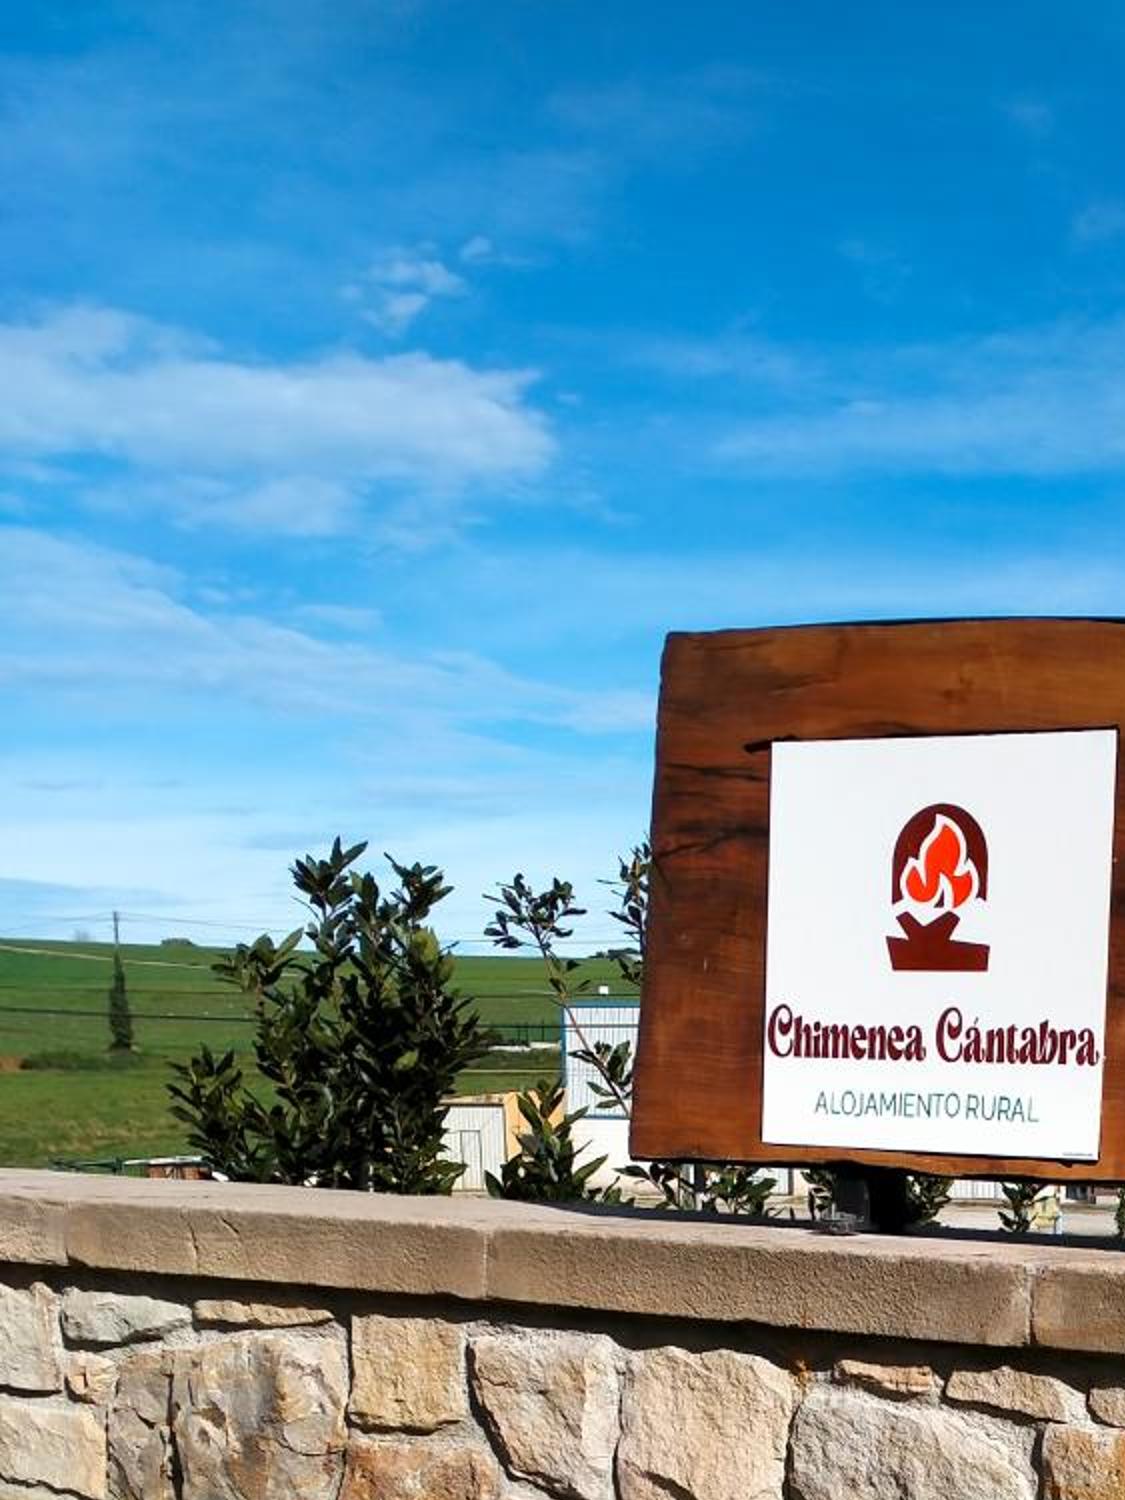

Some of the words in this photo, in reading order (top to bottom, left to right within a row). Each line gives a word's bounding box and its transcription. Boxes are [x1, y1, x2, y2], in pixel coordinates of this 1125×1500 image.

[767, 1003, 927, 1062] Chimenea
[935, 1006, 1100, 1066] Cántabra
[814, 1090, 961, 1119] ALOJAMIENTO
[965, 1093, 1040, 1123] RURAL
